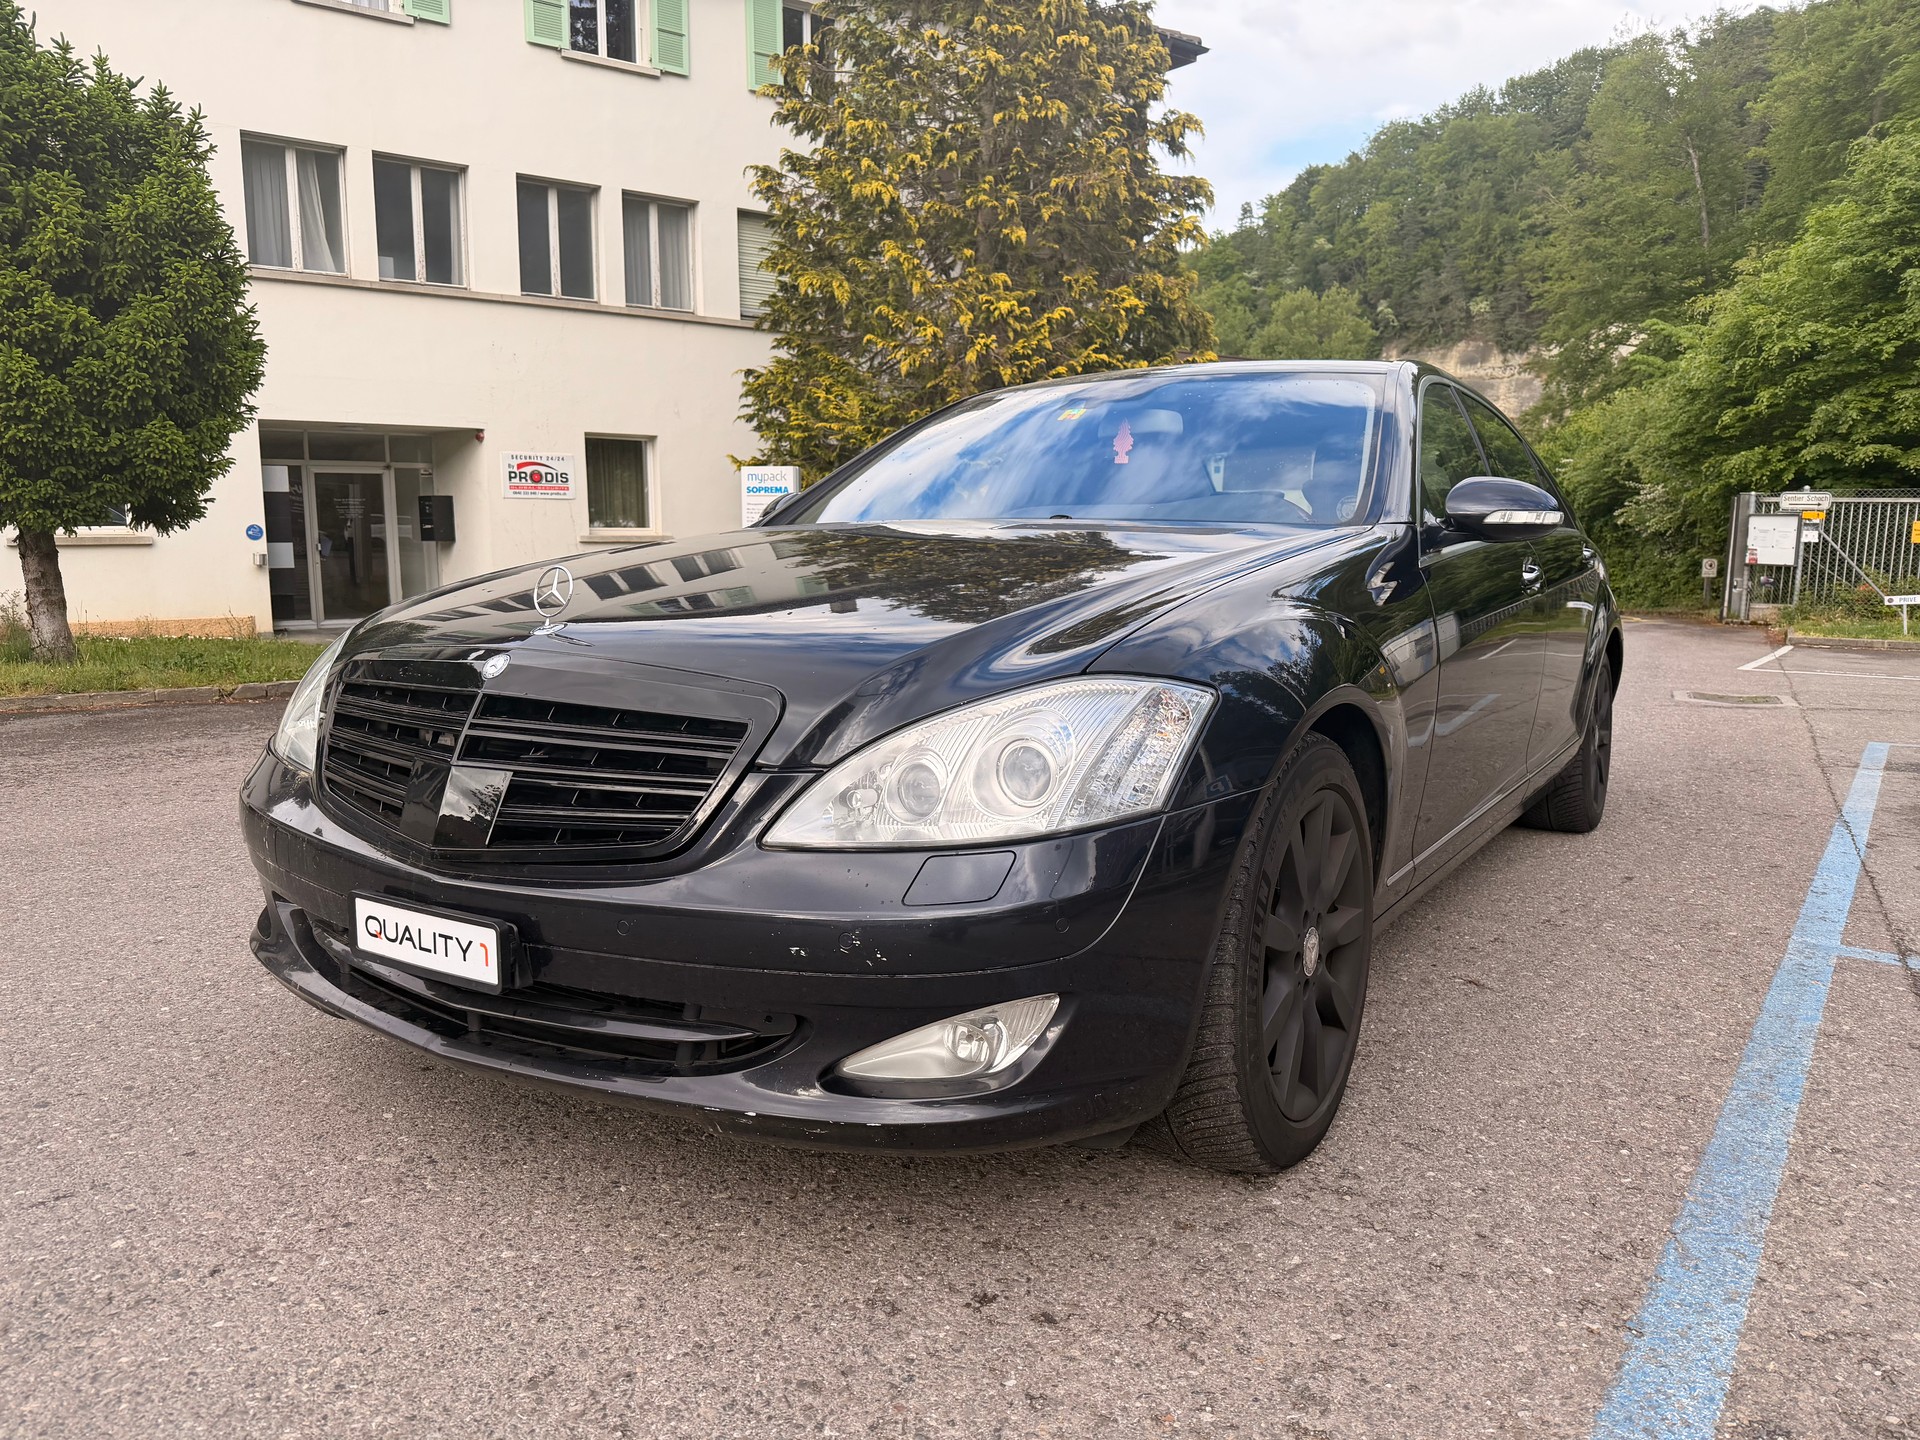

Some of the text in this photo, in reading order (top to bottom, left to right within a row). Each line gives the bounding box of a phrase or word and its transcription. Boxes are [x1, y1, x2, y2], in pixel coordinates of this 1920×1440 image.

[508, 469, 569, 484] PRODIS
[747, 470, 787, 484] mypack
[746, 486, 789, 494] SOPREMA
[365, 915, 489, 967] QUALITY 1
